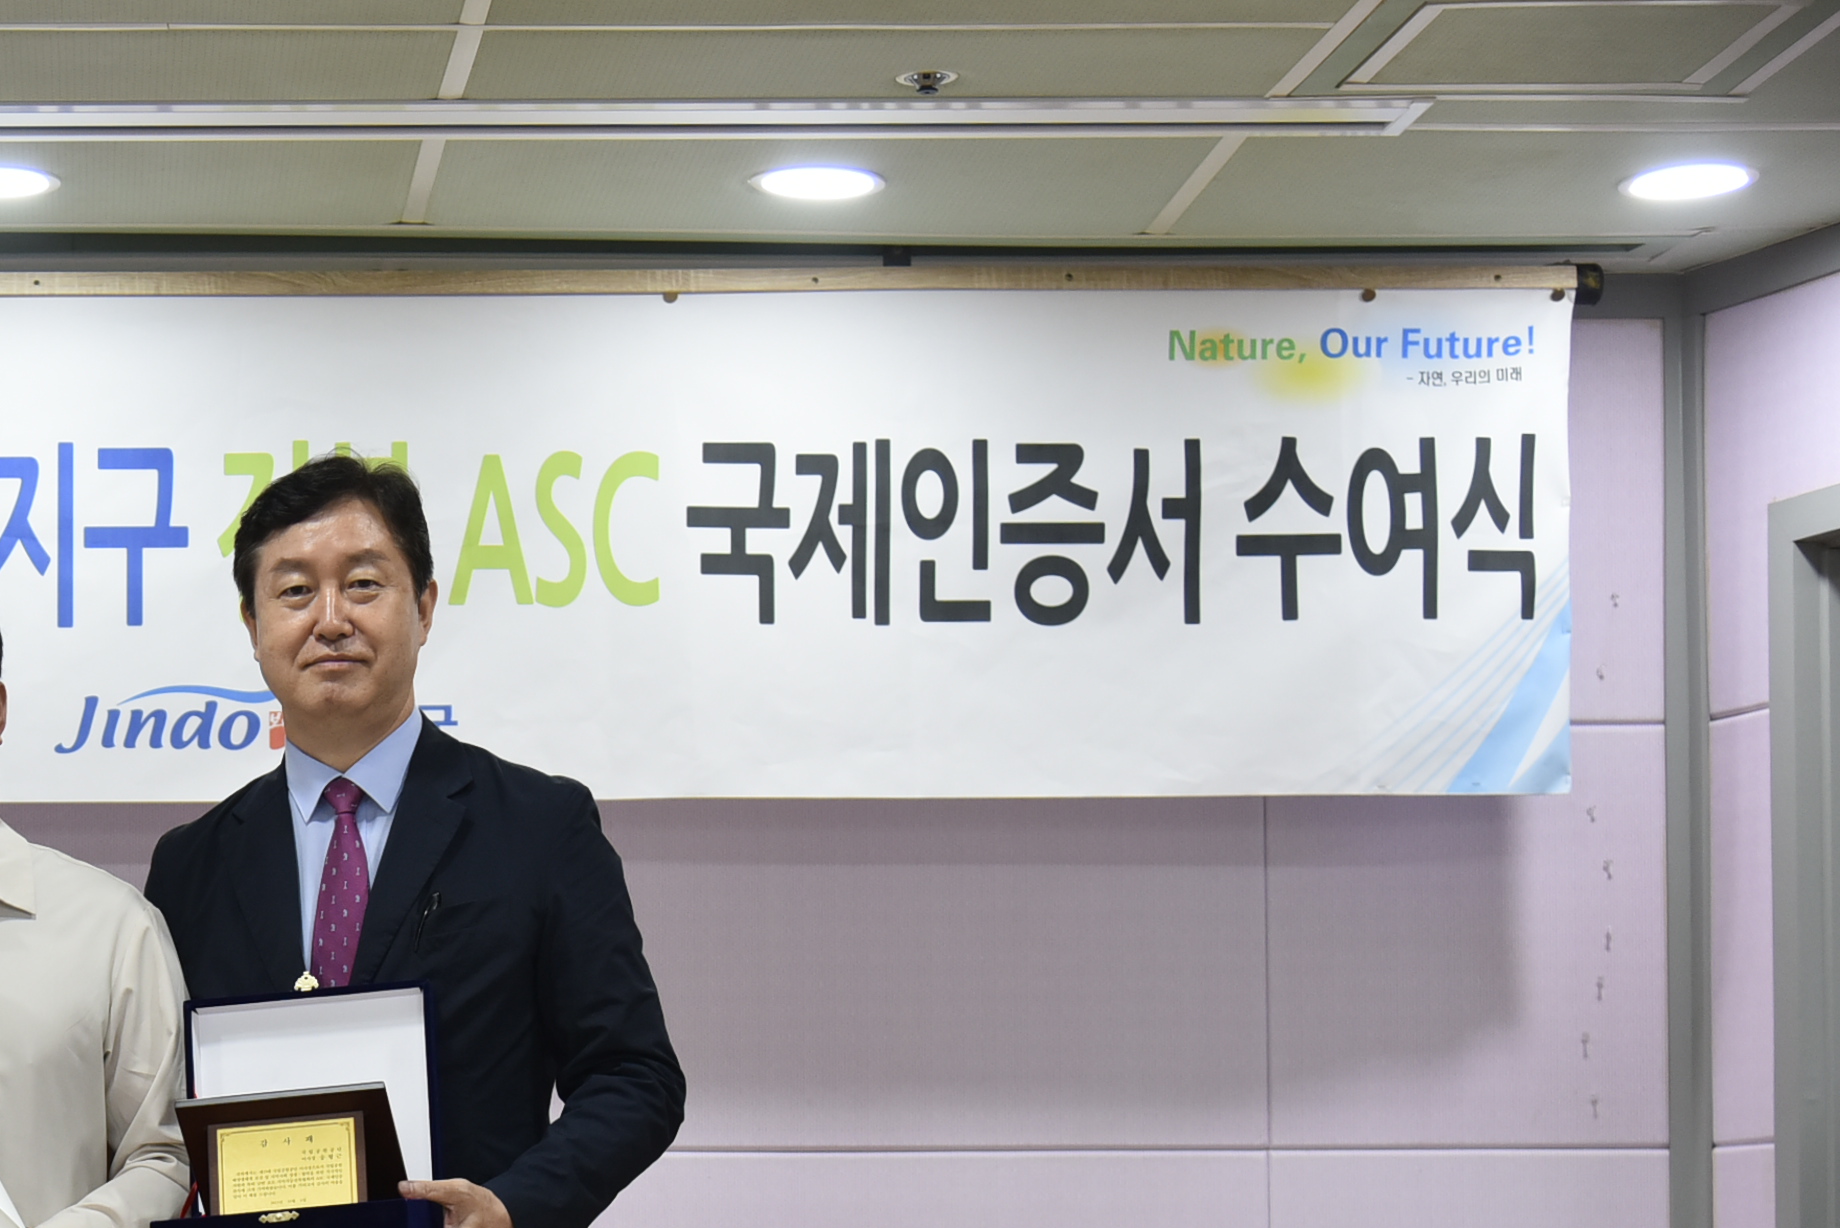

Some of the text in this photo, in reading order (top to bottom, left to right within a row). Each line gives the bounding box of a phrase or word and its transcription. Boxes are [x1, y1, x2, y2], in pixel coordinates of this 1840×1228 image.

[1168, 325, 1535, 364] Nature, Our Future!
[1450, 369, 1491, 386] 우리의
[1496, 366, 1523, 382] 미래
[448, 450, 661, 607] ASC
[685, 438, 1203, 627] 국제인증서
[1235, 433, 1537, 622] 수여식
[54, 694, 261, 754] Jindo
